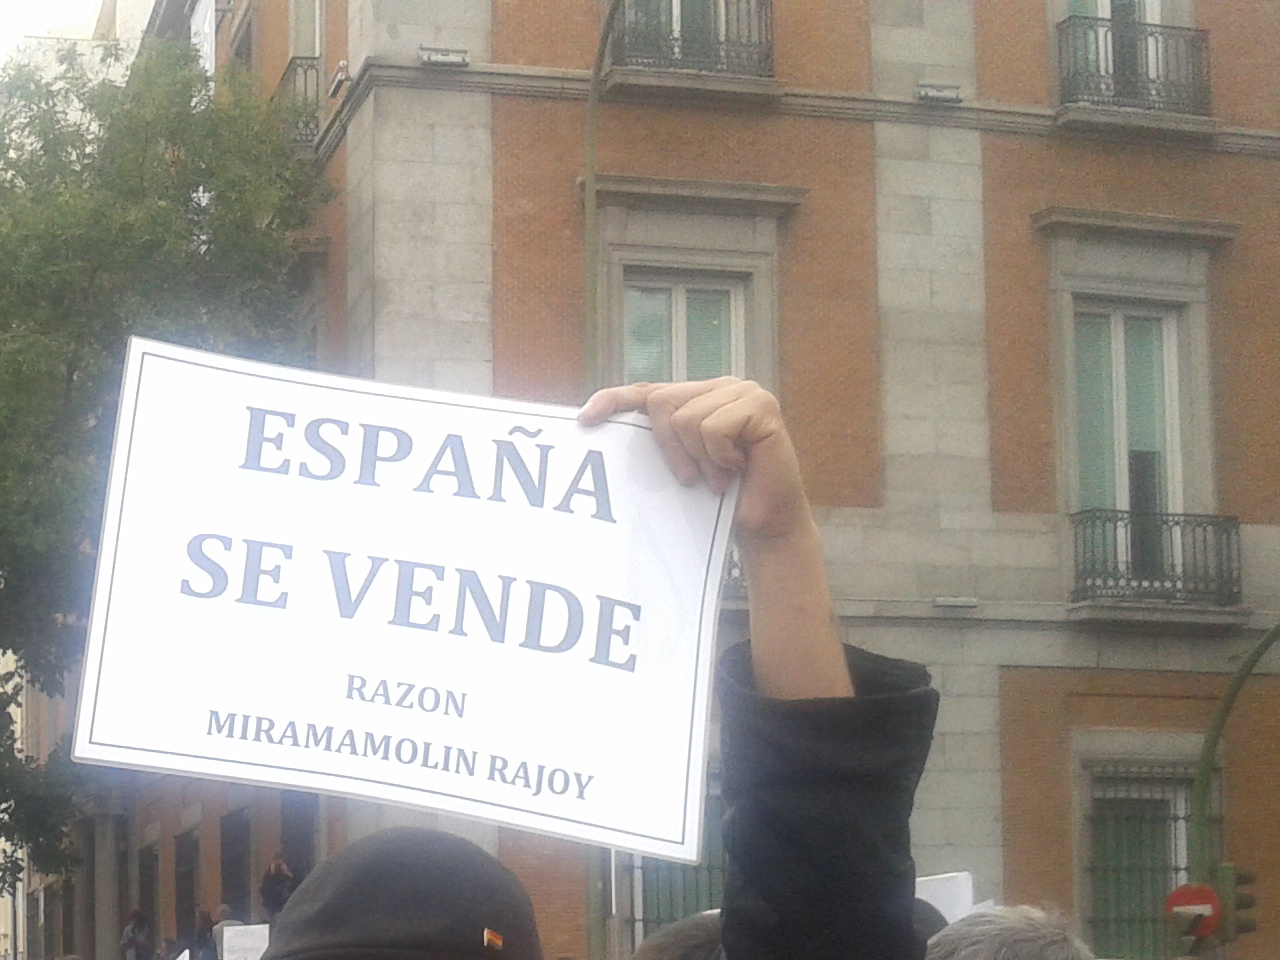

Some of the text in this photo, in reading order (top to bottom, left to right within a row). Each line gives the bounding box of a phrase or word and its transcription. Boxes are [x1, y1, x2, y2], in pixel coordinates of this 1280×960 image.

[238, 405, 618, 524] ESPAÑA
[180, 533, 642, 673] SE VENDE
[345, 674, 468, 718] RAZON
[206, 710, 595, 800] MIRAMAMOLIN RAJOY
